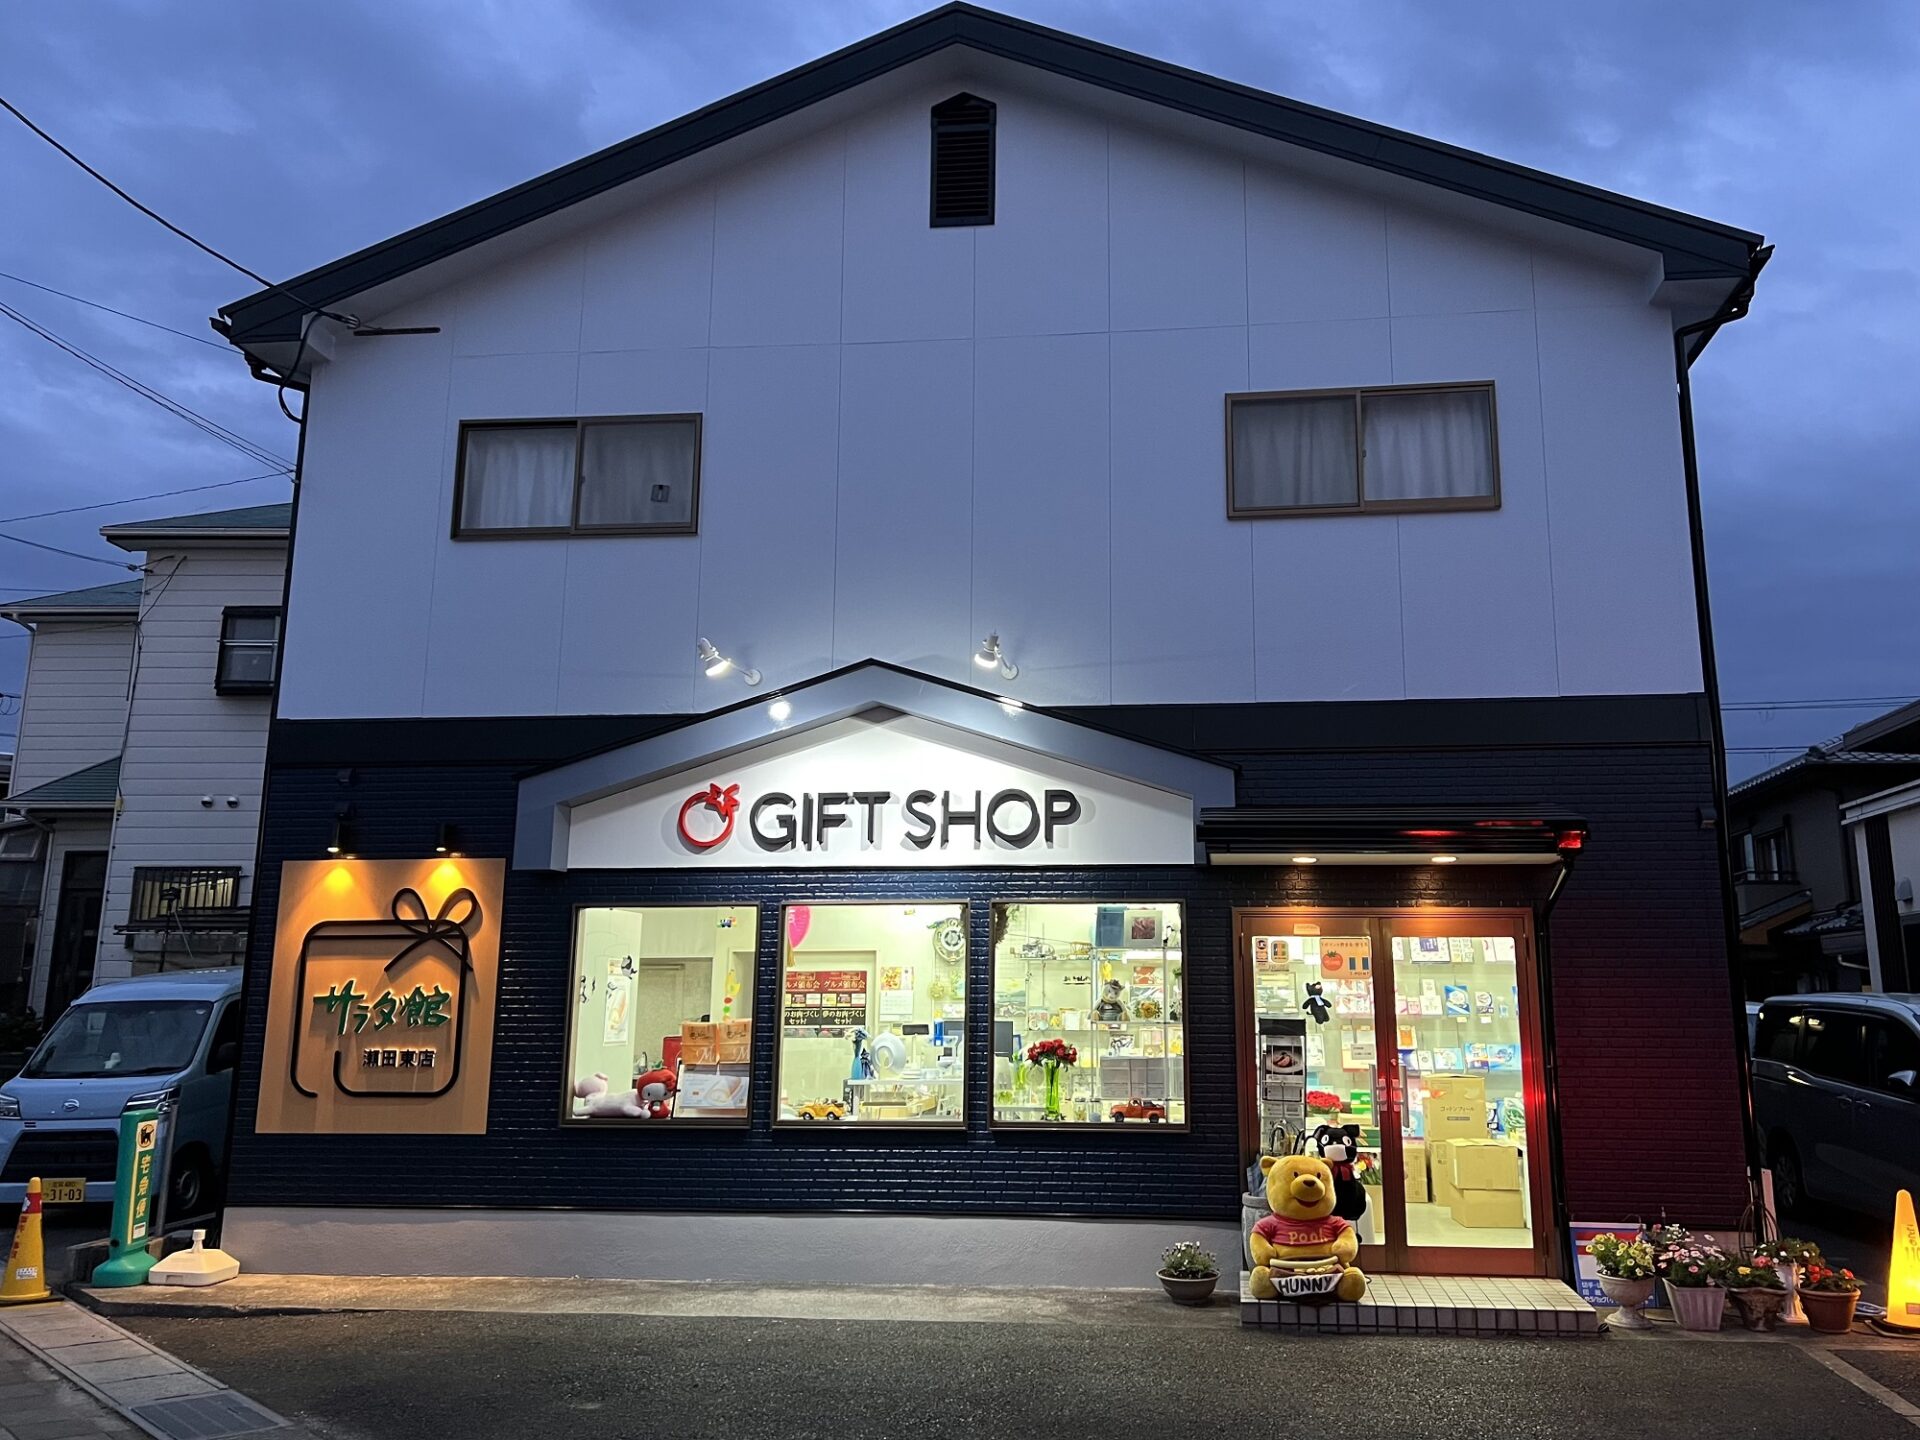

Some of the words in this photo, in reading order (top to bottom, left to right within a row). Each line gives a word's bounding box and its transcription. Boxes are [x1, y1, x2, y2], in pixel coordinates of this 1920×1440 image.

[749, 790, 891, 851] GIFT
[905, 788, 1082, 851] SHOP
[313, 979, 451, 1036] サラダ館
[362, 1048, 436, 1068] 瀬田東店
[136, 1154, 152, 1219] 宅急便
[1278, 1276, 1333, 1294] HUNNY
